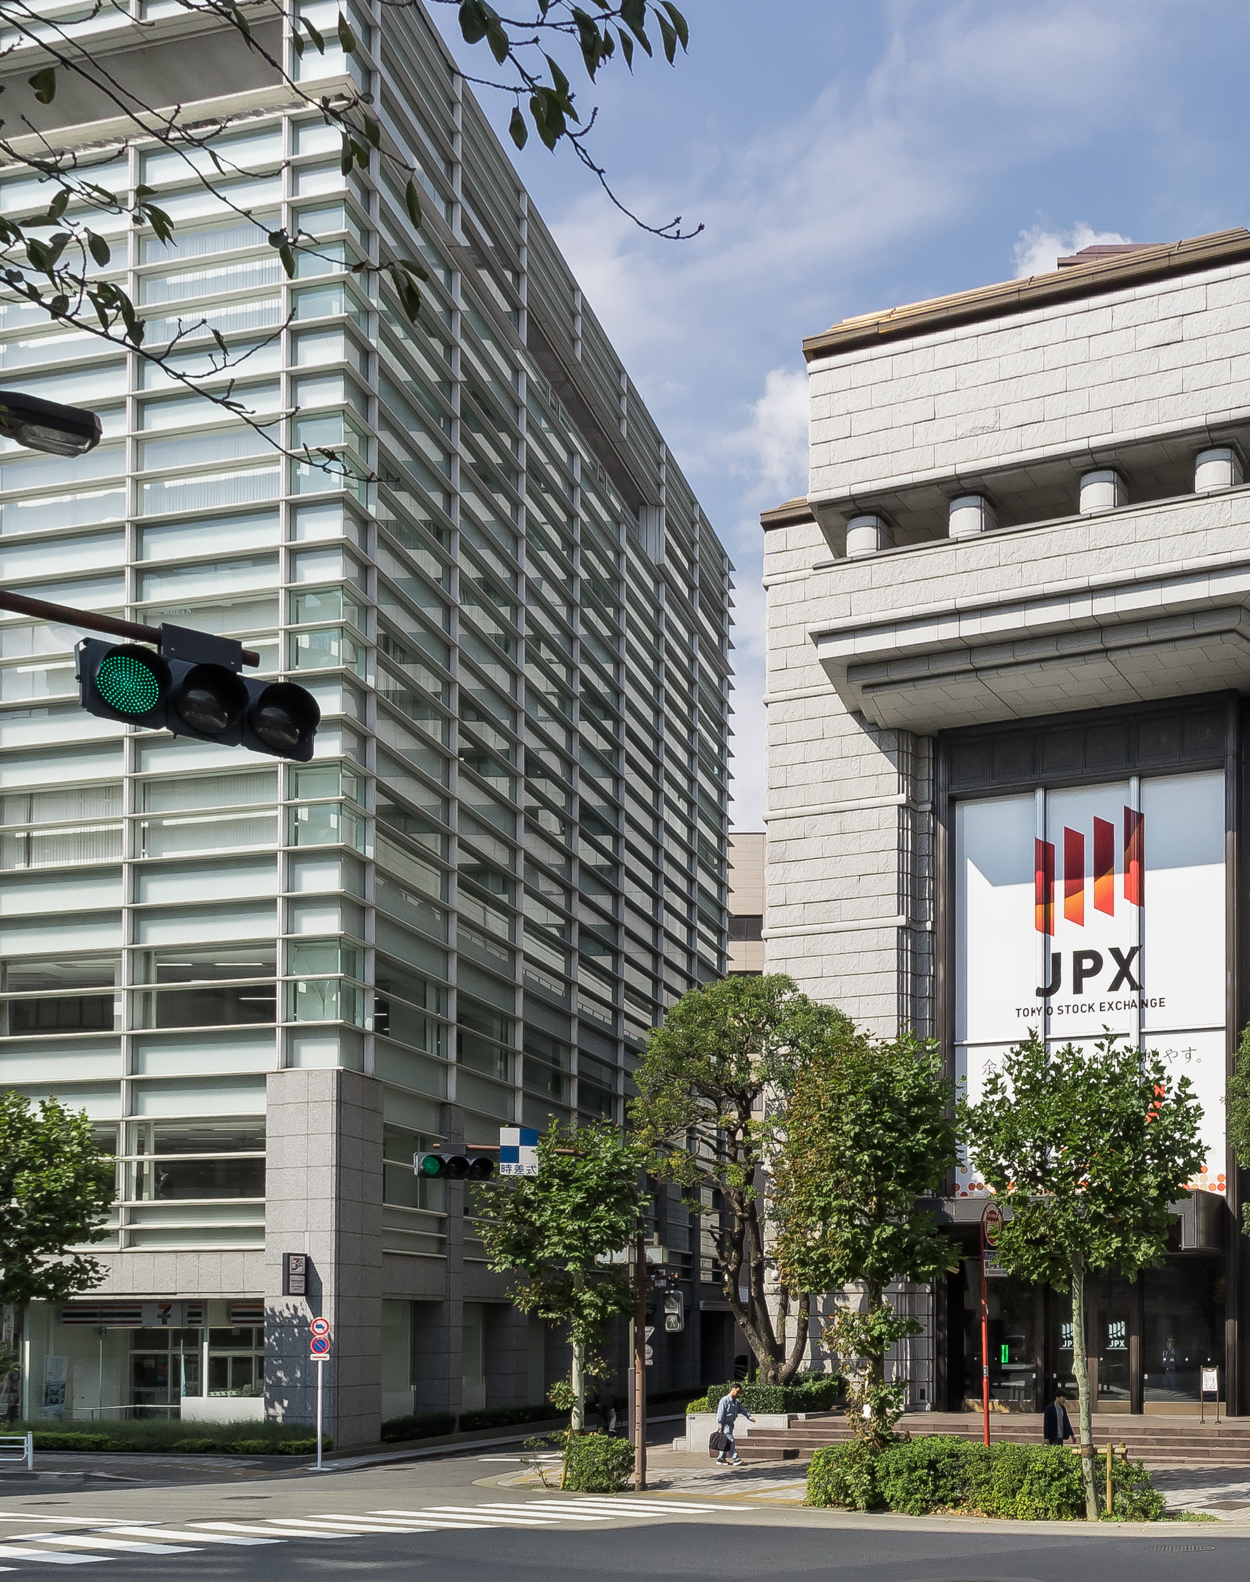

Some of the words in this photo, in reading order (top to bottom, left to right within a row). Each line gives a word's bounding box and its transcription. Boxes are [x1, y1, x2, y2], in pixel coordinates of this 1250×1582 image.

[1035, 945, 1144, 998] JPX
[1015, 1006, 1054, 1018] TOKYO
[1057, 1002, 1096, 1015] STOCK
[1099, 997, 1166, 1012] EXCHANGE
[500, 1164, 537, 1175] 時差式
